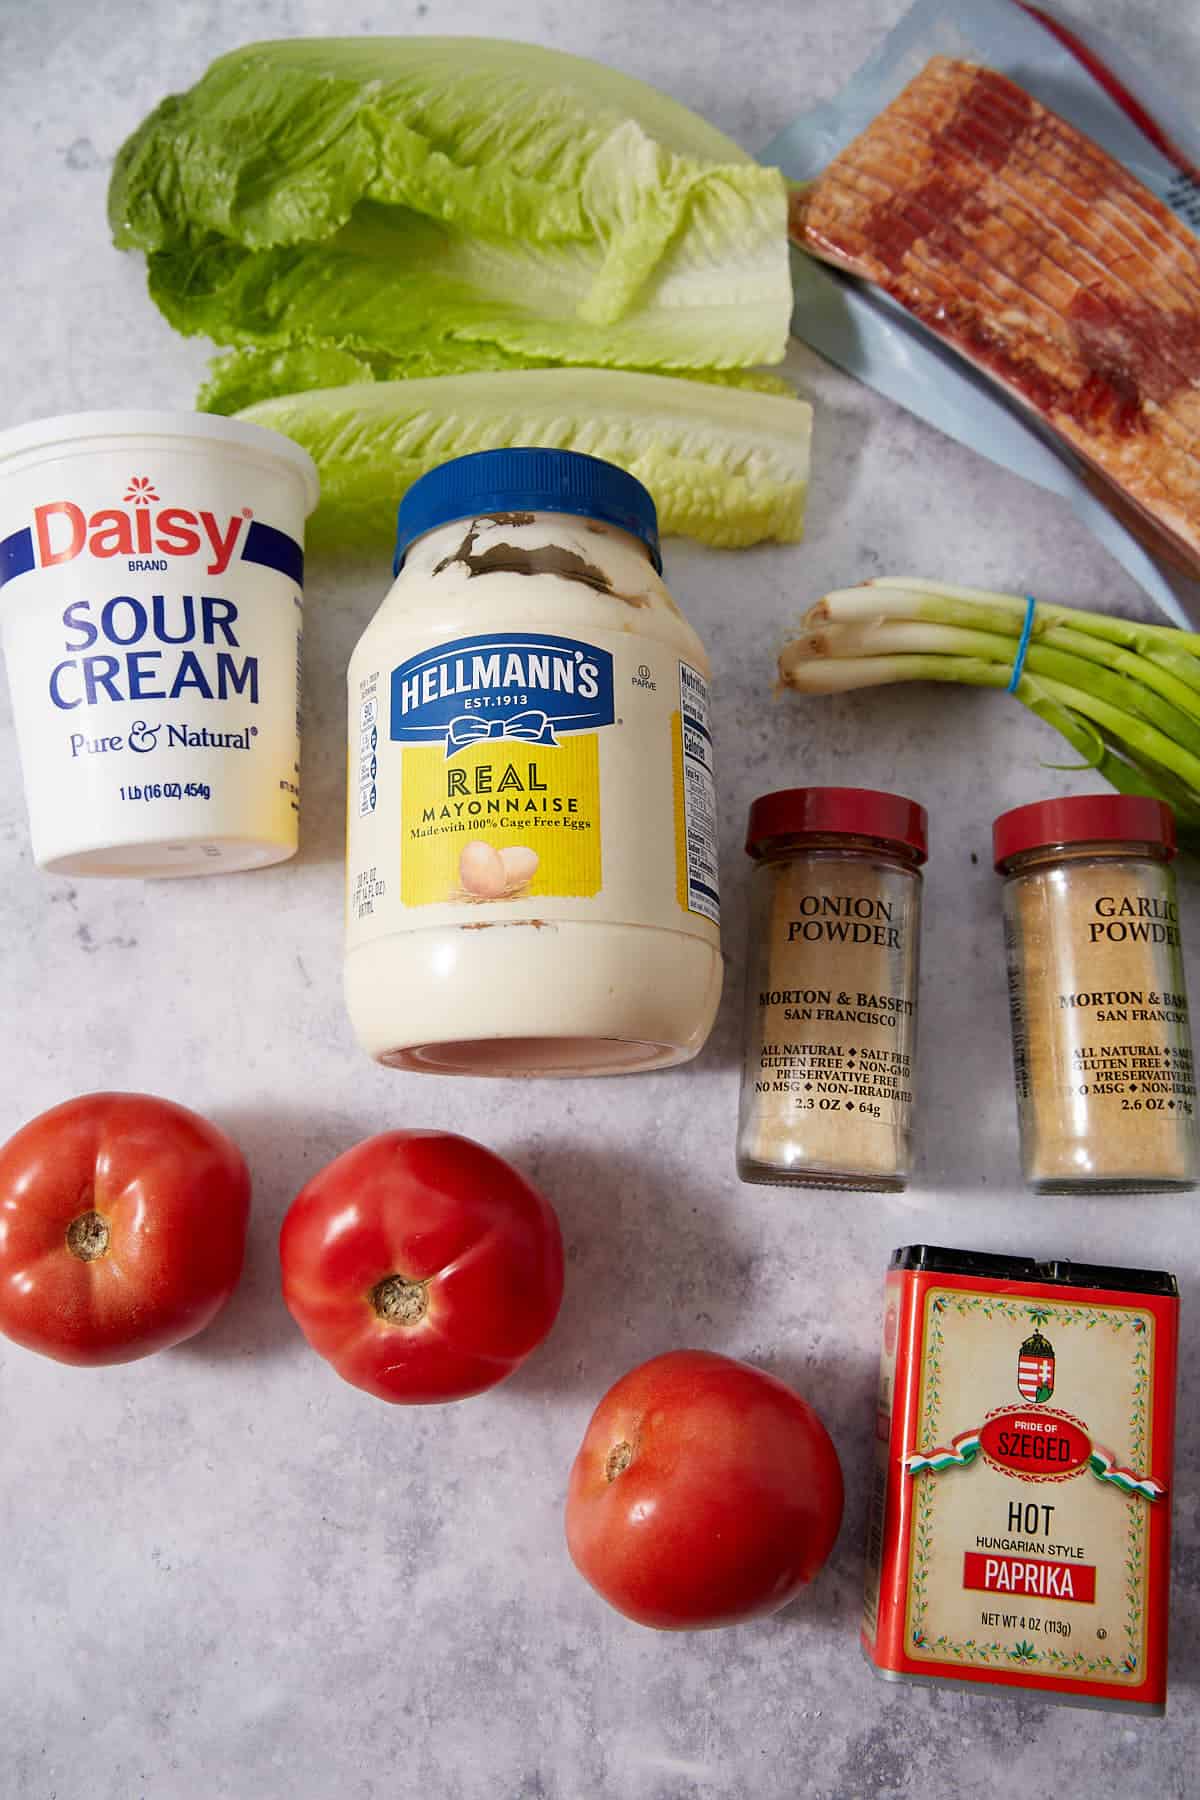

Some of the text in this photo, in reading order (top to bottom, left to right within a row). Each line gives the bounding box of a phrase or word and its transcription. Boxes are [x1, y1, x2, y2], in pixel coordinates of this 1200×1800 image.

[34, 500, 243, 575] Daisy
[128, 559, 168, 573] BRAND
[62, 595, 240, 652] SOUR
[49, 650, 259, 710] CREAM
[401, 651, 599, 716] HELLMANN'S
[631, 677, 657, 692] PARVE
[464, 695, 528, 709] EST.1913
[70, 733, 124, 757] Pure
[128, 720, 162, 753] &
[447, 763, 547, 797] REAL
[120, 787, 126, 801] 1
[143, 784, 161, 802] (16
[163, 783, 182, 800] OZ)
[184, 783, 211, 800] 454g
[422, 798, 578, 823] MAYONNAISE
[410, 816, 592, 840] Made with 100% Cage Free Eggs
[800, 896, 892, 922] ONION
[787, 921, 901, 950] POWDER
[1088, 921, 1181, 946] POWDE
[760, 990, 832, 1006] MORTON
[837, 991, 851, 1006] &
[1060, 991, 1143, 1008] MORTON
[1148, 991, 1160, 1005] &
[784, 1008, 897, 1028] SAN FRANCISCO
[1096, 1010, 1127, 1022] SAN
[760, 1045, 780, 1057] ALL
[783, 1044, 845, 1057] NATURAL
[860, 1048, 888, 1061] SALT
[1101, 1045, 1161, 1057] NATURAL
[760, 1057, 806, 1069] GLUTEN
[810, 1057, 843, 1069] FREE
[1132, 1058, 1161, 1069] FREE
[755, 1081, 770, 1093] NO
[773, 1081, 801, 1092] MSG
[776, 1069, 899, 1088] PRESERVATIVE FREE
[1093, 1083, 1125, 1095] MSG
[795, 1098, 881, 1118] 2.3 OZ 64g
[1122, 1099, 1142, 1111] 2.6
[1146, 1098, 1165, 1111] OZ
[1014, 1420, 1058, 1433] PRIDE OF
[998, 1432, 1071, 1463] SZEGED
[1008, 1501, 1055, 1536] HOT
[976, 1536, 1085, 1559] HUNGARIAN STYLE
[984, 1559, 1074, 1598] PAPRIKA
[981, 1612, 1072, 1638] NET WT 4 OZ (113g)
